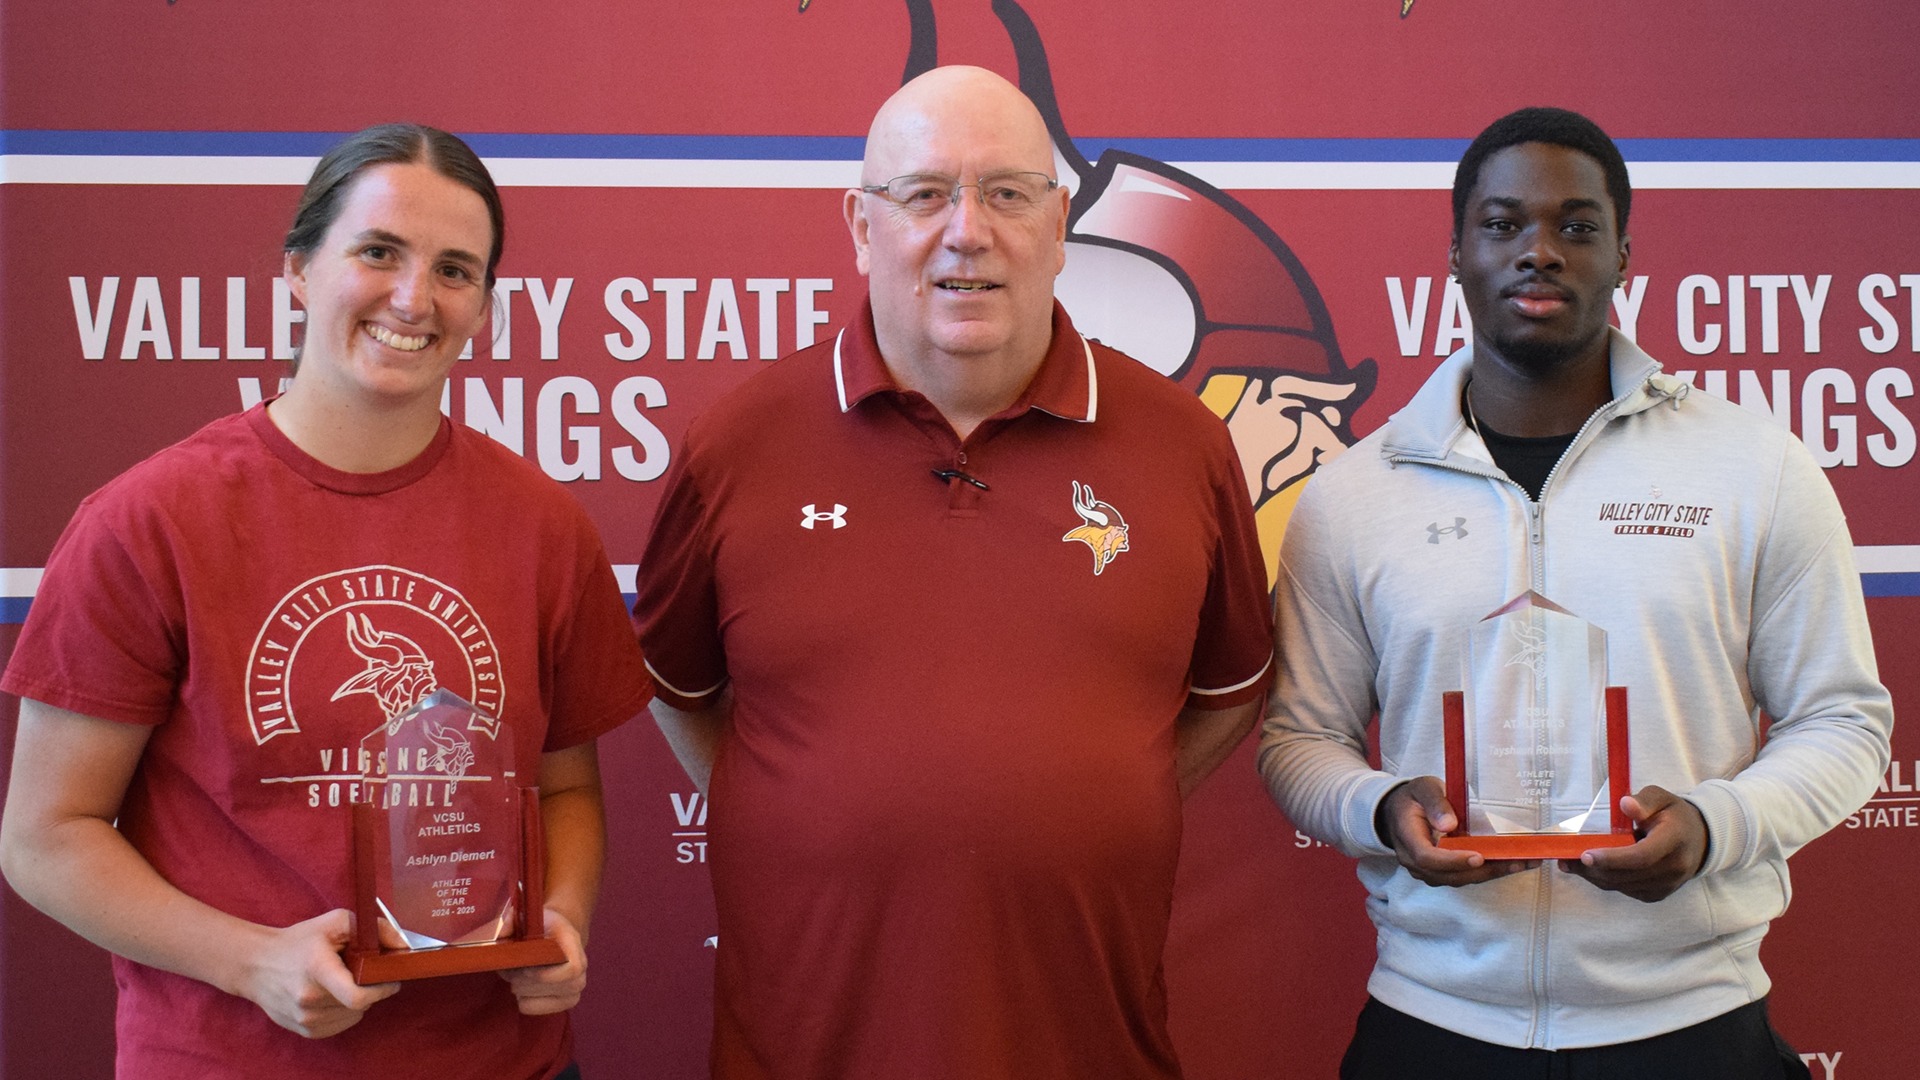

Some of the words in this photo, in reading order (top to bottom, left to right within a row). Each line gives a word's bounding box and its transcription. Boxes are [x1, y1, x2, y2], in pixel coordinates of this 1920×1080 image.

[68, 276, 309, 361] VALLE
[1385, 275, 1650, 357] VAY
[1676, 273, 1832, 355] CITY
[1599, 503, 1644, 521] VALLEY
[1644, 503, 1673, 521] CITY
[1674, 505, 1712, 526] STATE
[1617, 525, 1649, 534] TRACK
[1664, 526, 1693, 537] FIELD
[256, 639, 289, 730] VALLEY
[280, 585, 333, 631] CITY
[341, 574, 416, 601] STATE
[427, 591, 498, 728] UNIVERSITY
[1516, 770, 1555, 779] ATHLETE
[1520, 779, 1532, 788] OF
[1534, 779, 1551, 788] THE
[1524, 788, 1549, 797] YEAR
[433, 812, 465, 823] VCSU
[418, 823, 481, 837] ATHLETICS
[406, 853, 447, 867] Ashlyn
[450, 849, 495, 862] Diemert
[432, 878, 472, 888] ATHLETE
[437, 889, 449, 897] OF
[451, 887, 468, 896] THE
[442, 897, 465, 906] YEAR
[431, 908, 450, 917] 2024
[456, 906, 475, 915] 2025
